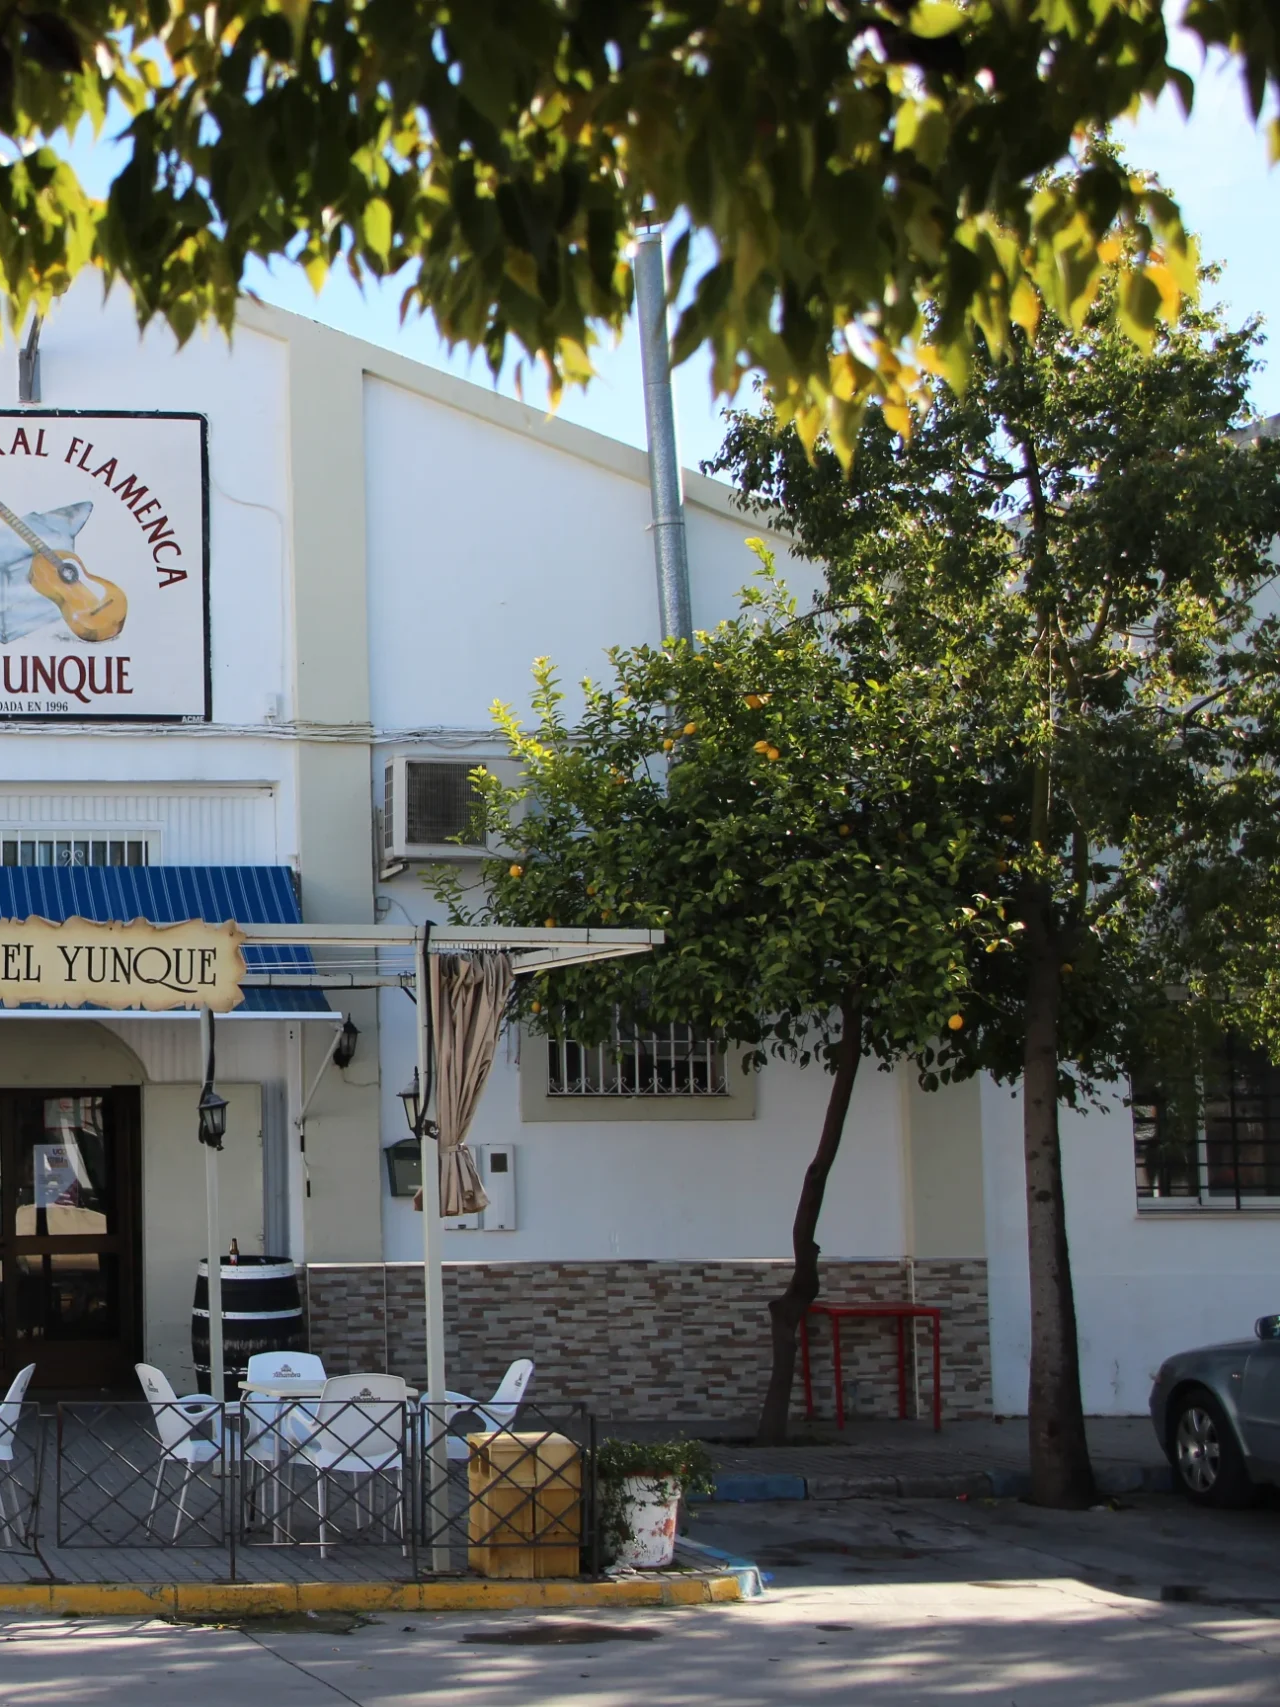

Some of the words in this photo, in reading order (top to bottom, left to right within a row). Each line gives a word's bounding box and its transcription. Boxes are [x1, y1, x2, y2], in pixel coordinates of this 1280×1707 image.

[64, 436, 188, 588] FLAMENCA
[27, 701, 41, 712] EN
[46, 701, 69, 712] 1996
[181, 715, 205, 724] ACME
[1, 944, 42, 983] EL
[57, 945, 218, 994] YUNQUE
